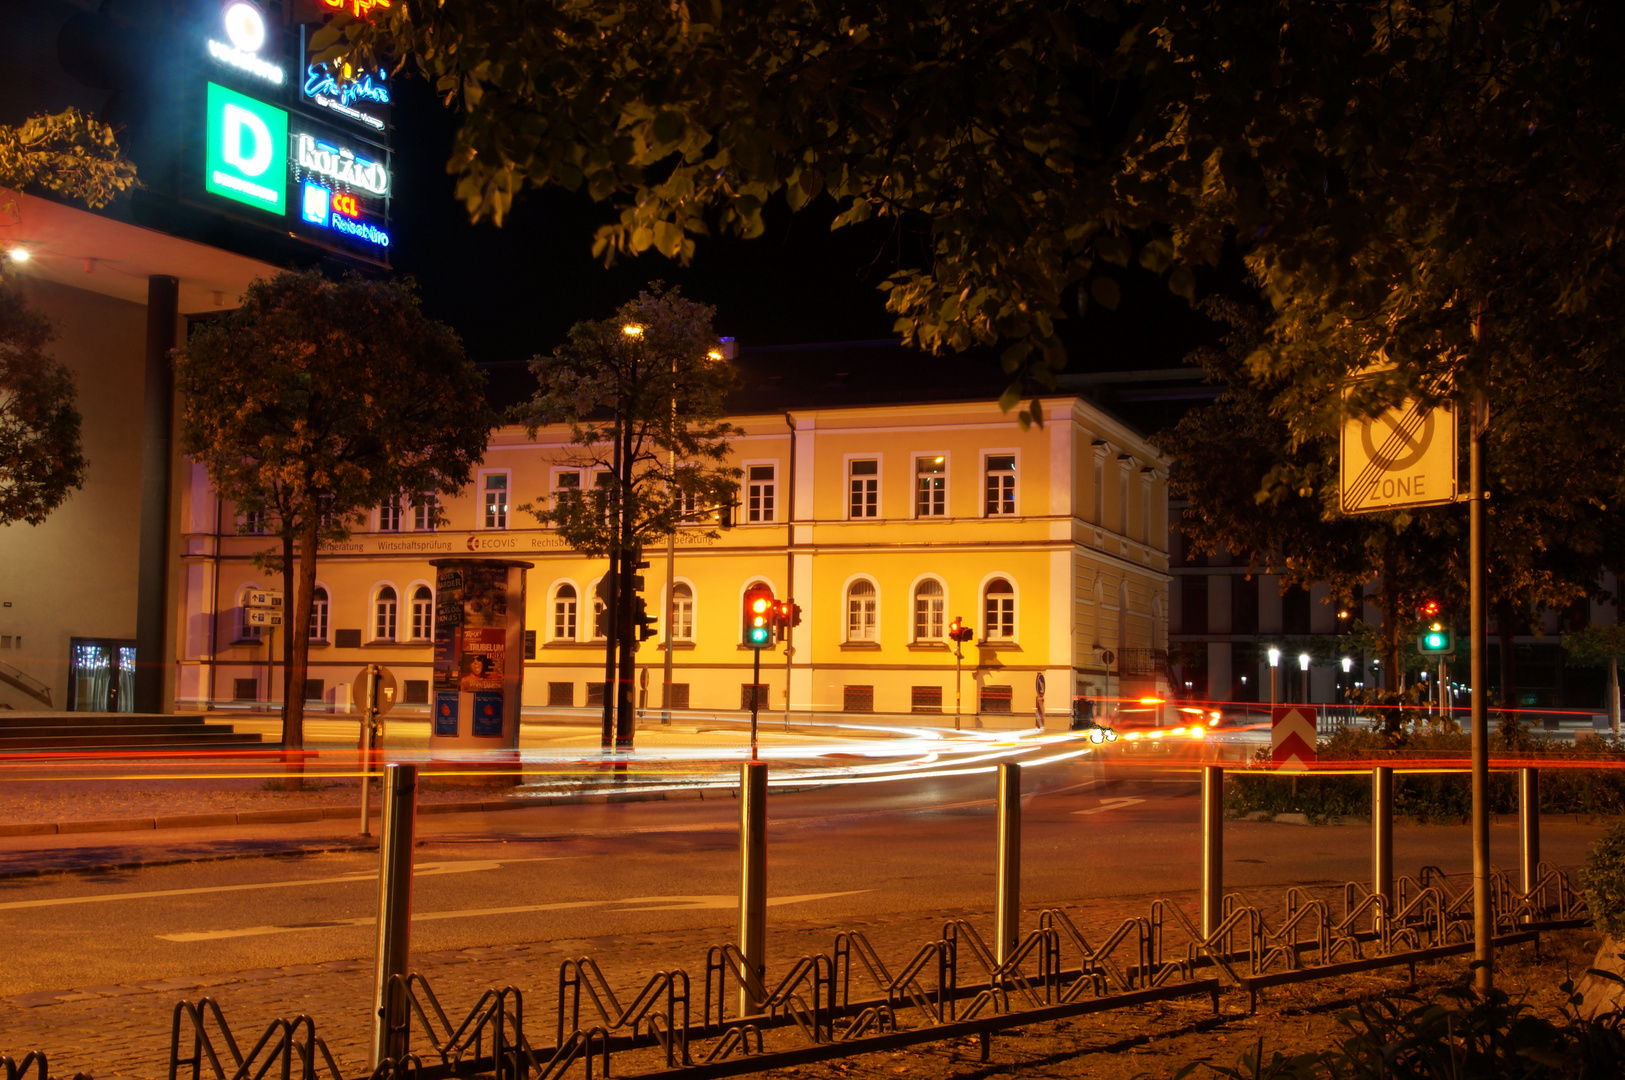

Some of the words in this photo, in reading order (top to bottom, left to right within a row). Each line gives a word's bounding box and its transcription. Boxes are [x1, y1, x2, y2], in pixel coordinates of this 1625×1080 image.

[224, 103, 273, 176] D
[333, 193, 358, 217] CCL
[332, 212, 389, 247] Reisebüro
[1370, 475, 1426, 501] ZONE
[377, 540, 452, 551] Wirtschaftsprüfung
[481, 538, 517, 549] ECOVIS
